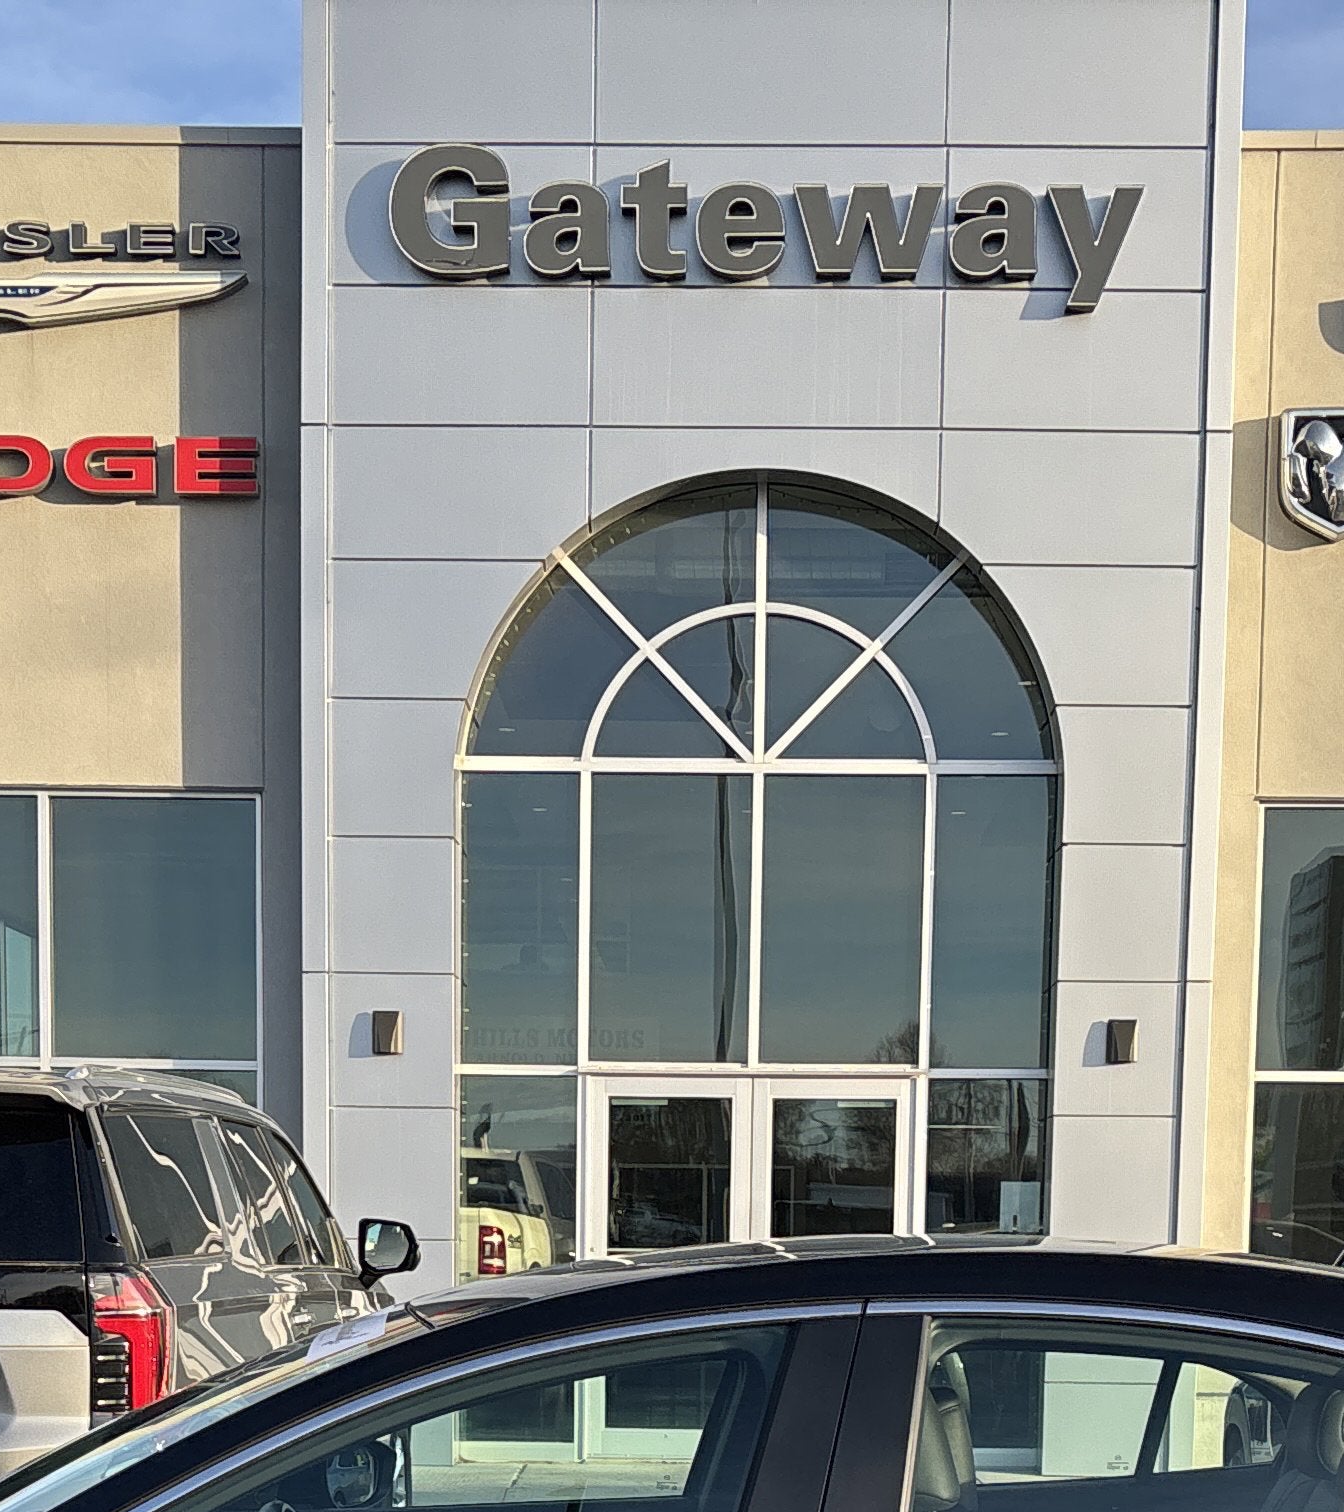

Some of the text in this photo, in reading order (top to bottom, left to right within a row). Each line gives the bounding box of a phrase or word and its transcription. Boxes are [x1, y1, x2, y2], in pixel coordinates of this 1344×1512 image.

[387, 142, 1145, 313] Gateway
[465, 1027, 645, 1049] HILLS MOORS
